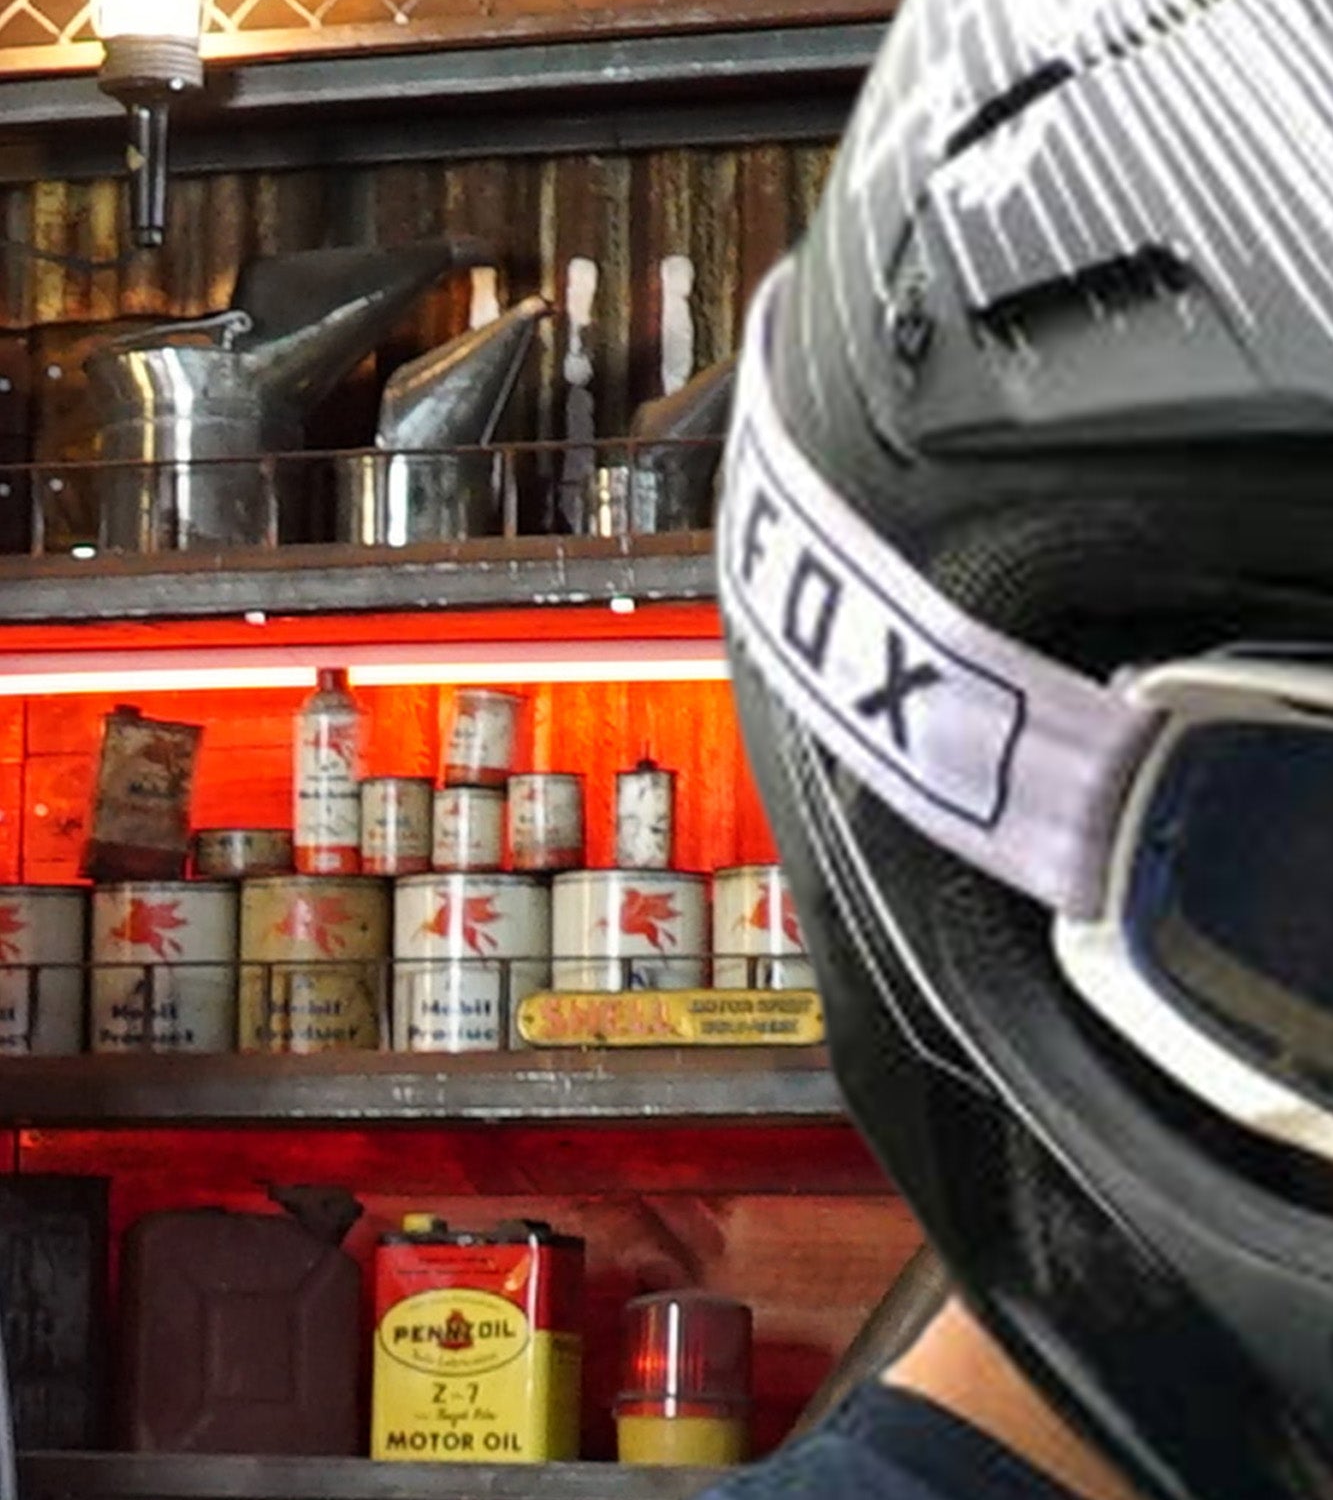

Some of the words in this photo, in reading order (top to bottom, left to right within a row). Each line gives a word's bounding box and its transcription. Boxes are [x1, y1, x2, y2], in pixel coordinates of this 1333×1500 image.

[743, 486, 945, 754] FOX
[542, 996, 680, 1037] SHELL
[386, 1431, 474, 1453] MOTOR
[483, 1431, 522, 1453] OIL
